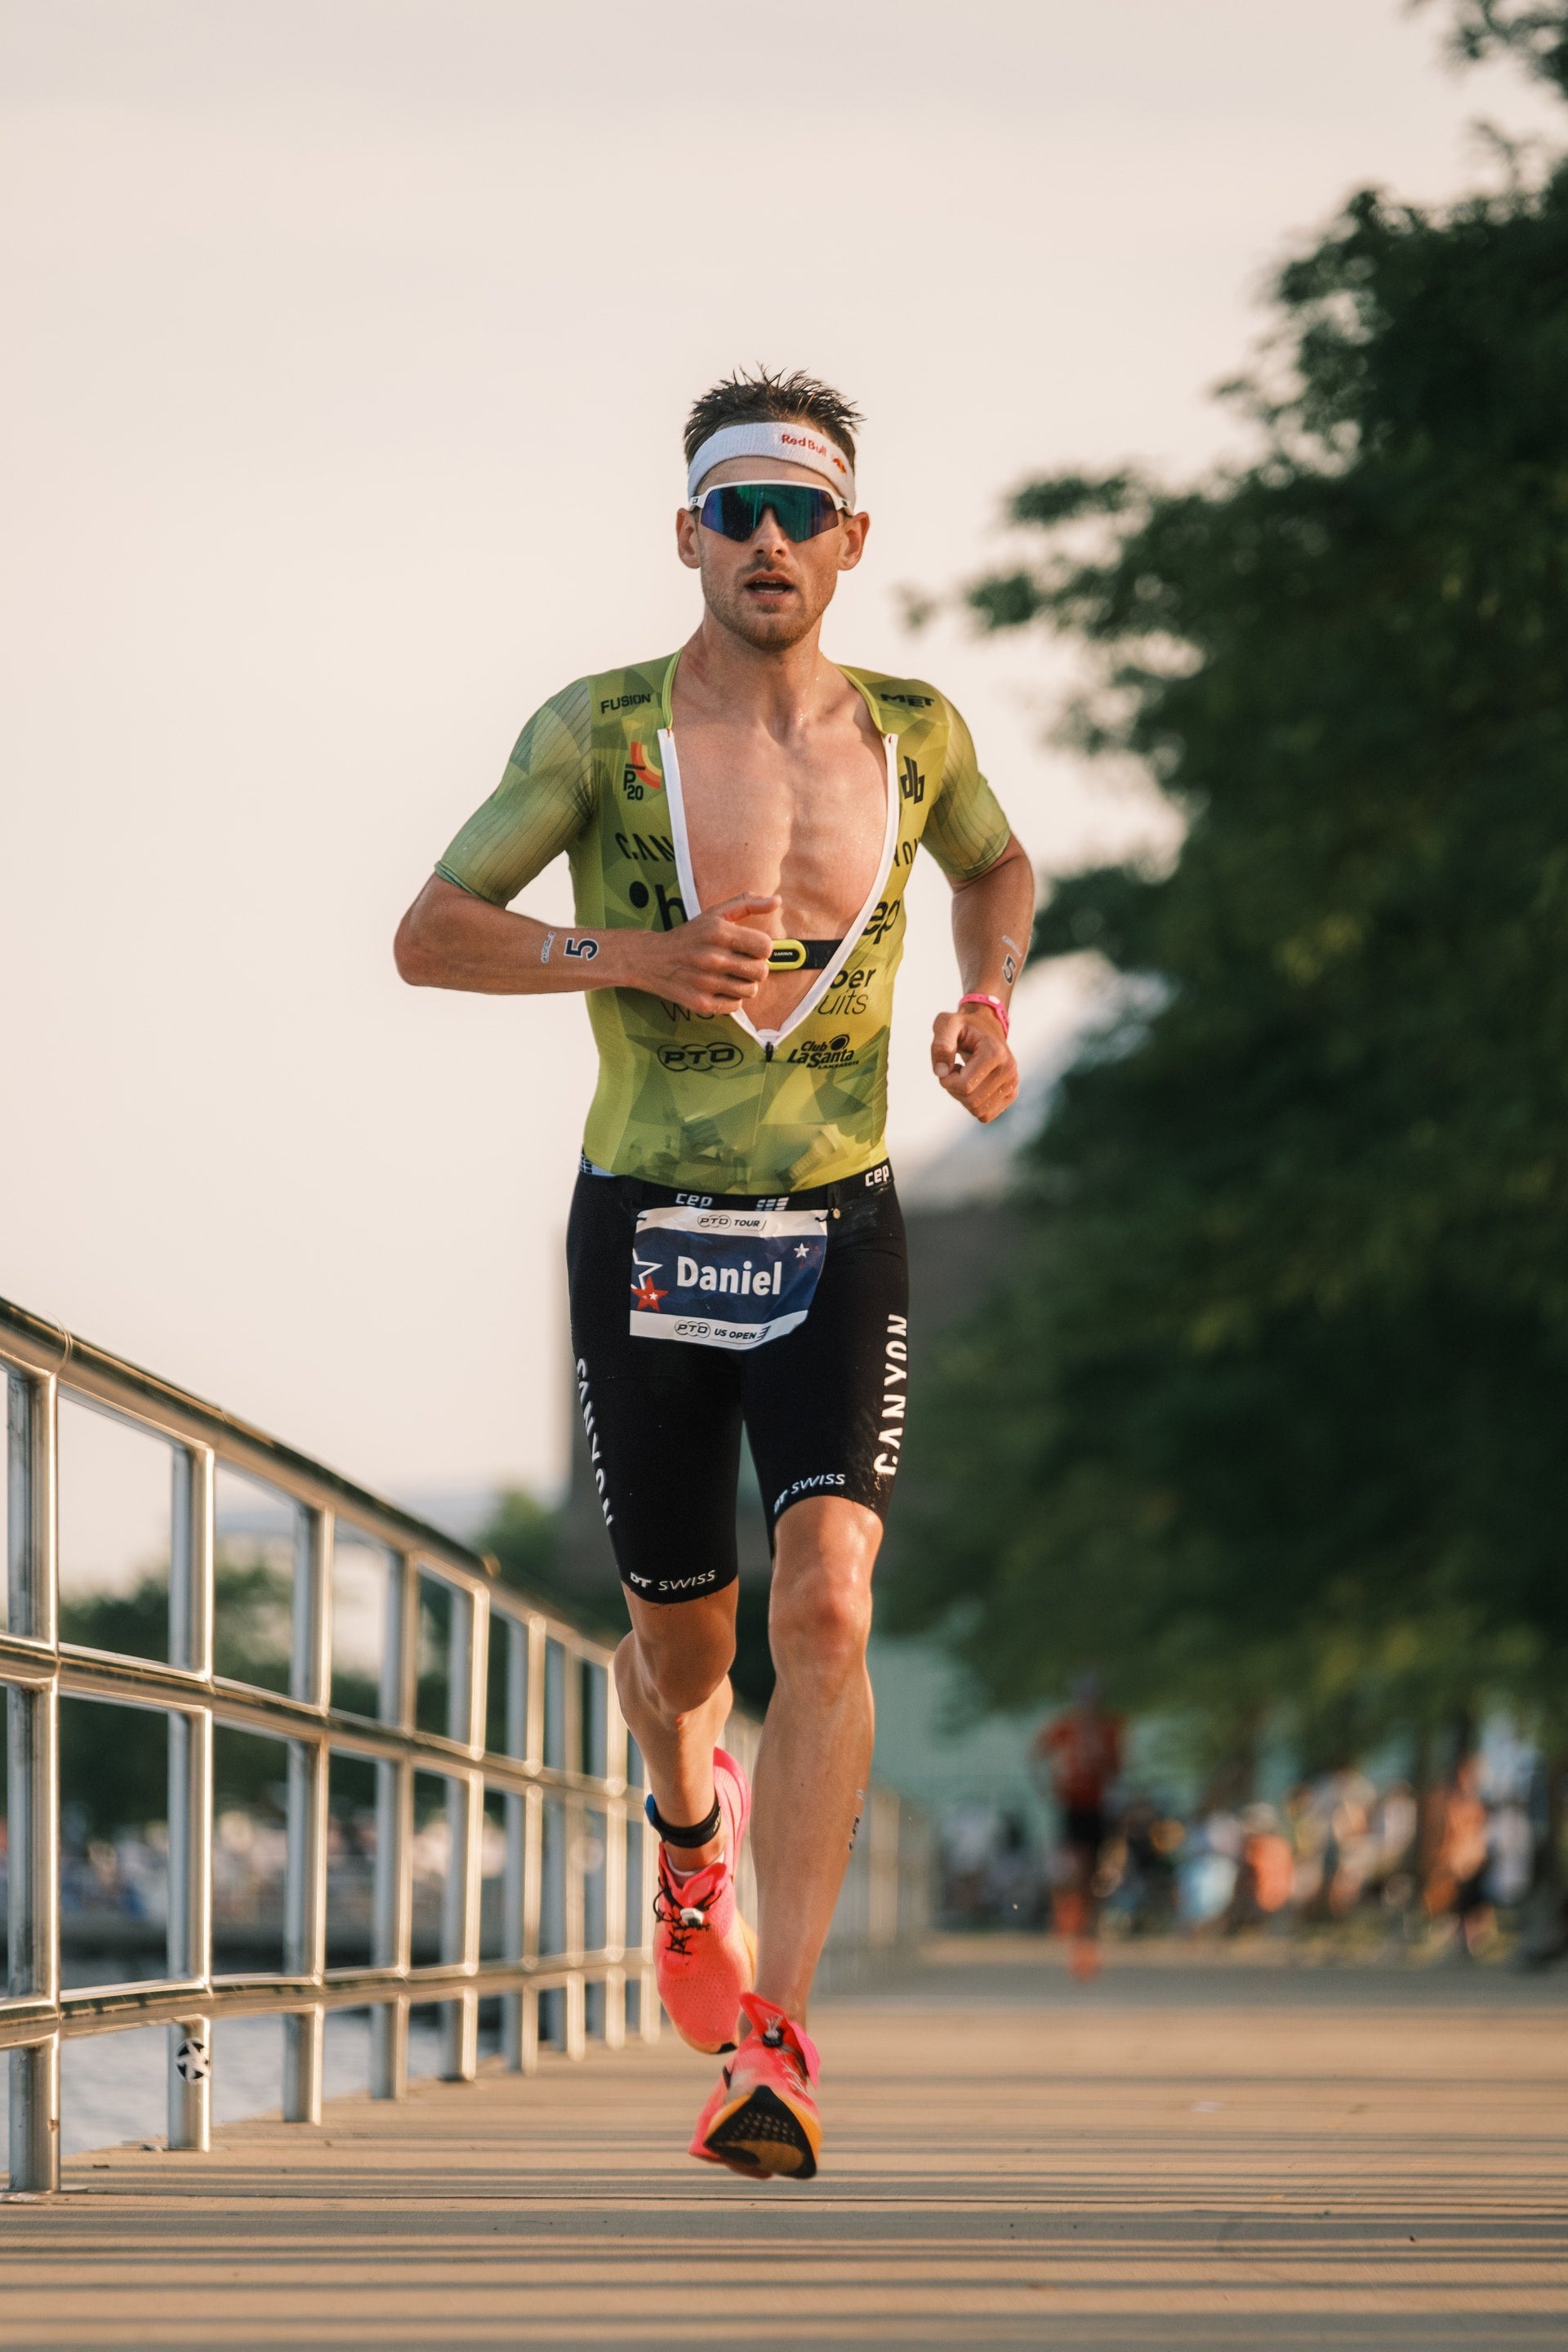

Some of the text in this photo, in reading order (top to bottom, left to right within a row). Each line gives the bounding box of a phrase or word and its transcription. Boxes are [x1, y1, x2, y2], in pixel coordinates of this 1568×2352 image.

[782, 434, 827, 457] Red Bull
[600, 693, 652, 714] FUSION
[880, 693, 935, 708] MET
[627, 784, 644, 800] 20
[564, 938, 599, 960] 5
[1003, 954, 1017, 985] 5
[662, 1046, 737, 1066] PTO
[800, 1040, 828, 1052] Club
[865, 1165, 889, 1187] cep
[675, 1192, 713, 1209] cep
[699, 1216, 760, 1227] PTO TOUR
[676, 1255, 782, 1295] Daniel
[676, 1323, 757, 1339] PTO US OPEN
[873, 1313, 907, 1477] CANYON
[790, 1473, 846, 1495] SWISS
[657, 1569, 716, 1591] SWISS
